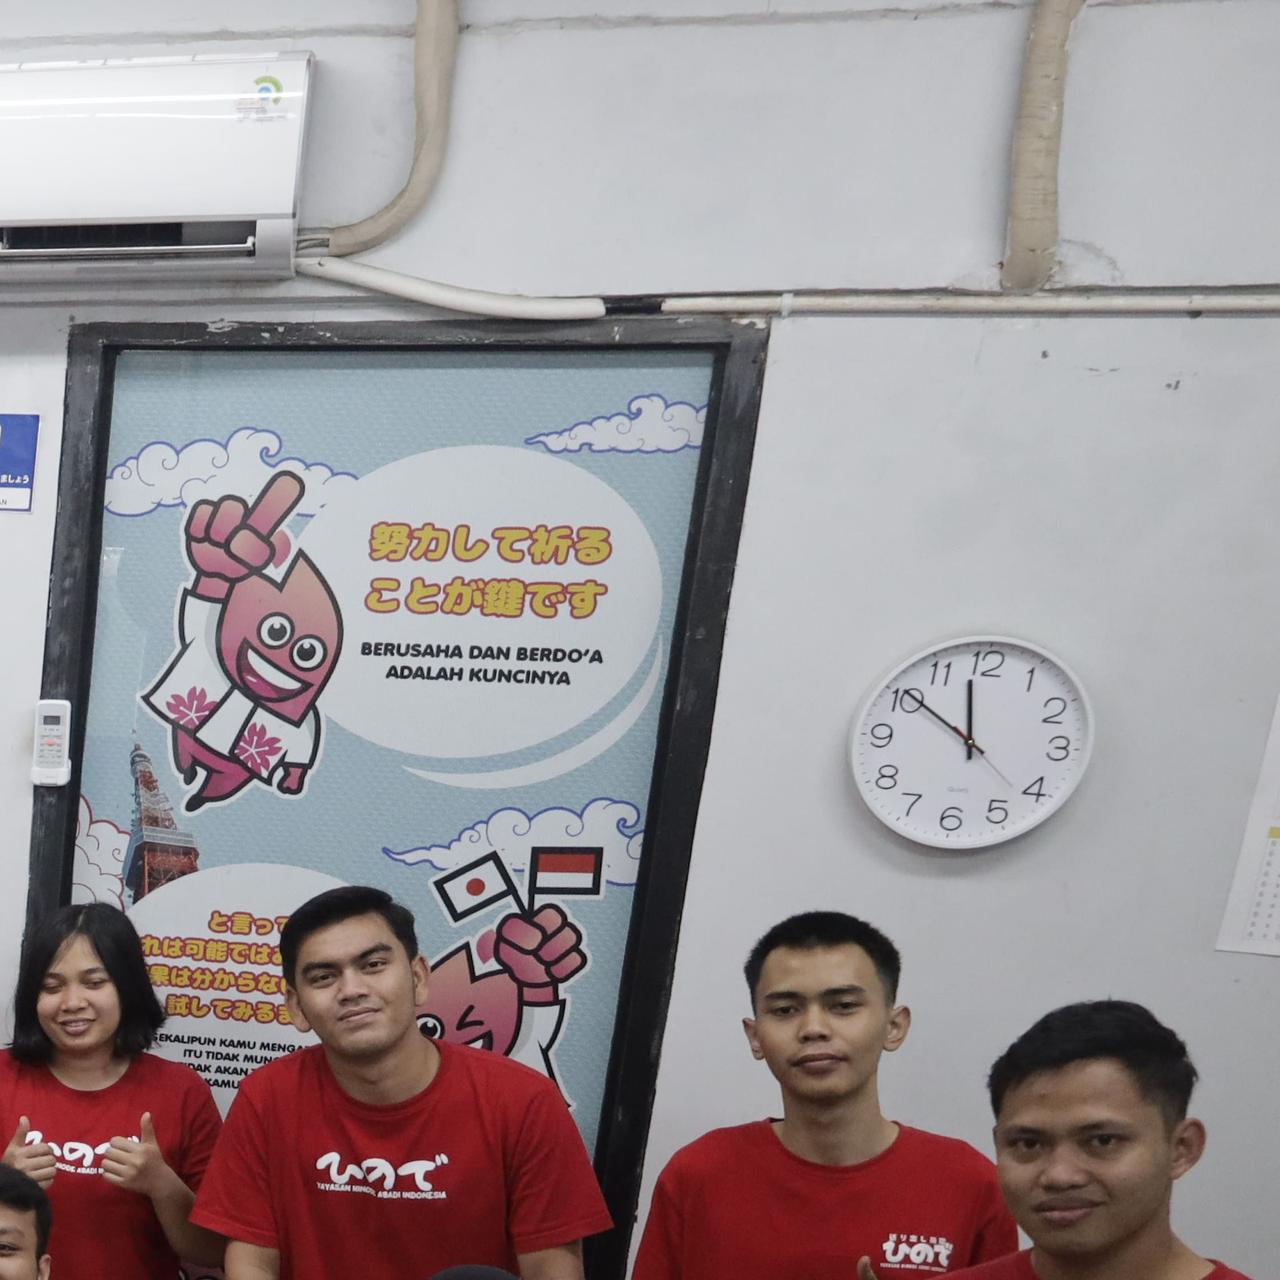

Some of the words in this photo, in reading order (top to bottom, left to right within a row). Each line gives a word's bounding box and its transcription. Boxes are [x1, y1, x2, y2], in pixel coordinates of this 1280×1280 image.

[368, 521, 612, 565] 努力して祈る
[364, 576, 608, 619] ことが鍵です
[360, 641, 463, 659] BERUSAHA
[468, 644, 511, 661] DAN
[972, 650, 1006, 678] 12
[385, 665, 464, 682] ADALAH
[468, 668, 571, 686] KUNCINYA
[930, 661, 953, 688] 11
[1026, 667, 1036, 693] 1
[891, 687, 925, 713] 10
[1042, 697, 1068, 725] 2
[870, 723, 894, 748] 9
[1046, 735, 1071, 761] 3
[875, 764, 899, 790] 8
[1022, 776, 1047, 803] 4
[901, 792, 923, 817] 7
[986, 799, 1009, 824] 5
[940, 806, 963, 831] 6
[182, 1049, 203, 1059] ITU
[205, 1050, 240, 1062] TIDAK
[219, 1037, 257, 1050] KAMU
[214, 1065, 248, 1077] AKAN
[77, 1167, 97, 1175] ABADI
[315, 1151, 449, 1192] ひので
[377, 1190, 400, 1198] ABADI
[402, 1191, 447, 1199] INDONESIA
[882, 1241, 954, 1268] ひので
